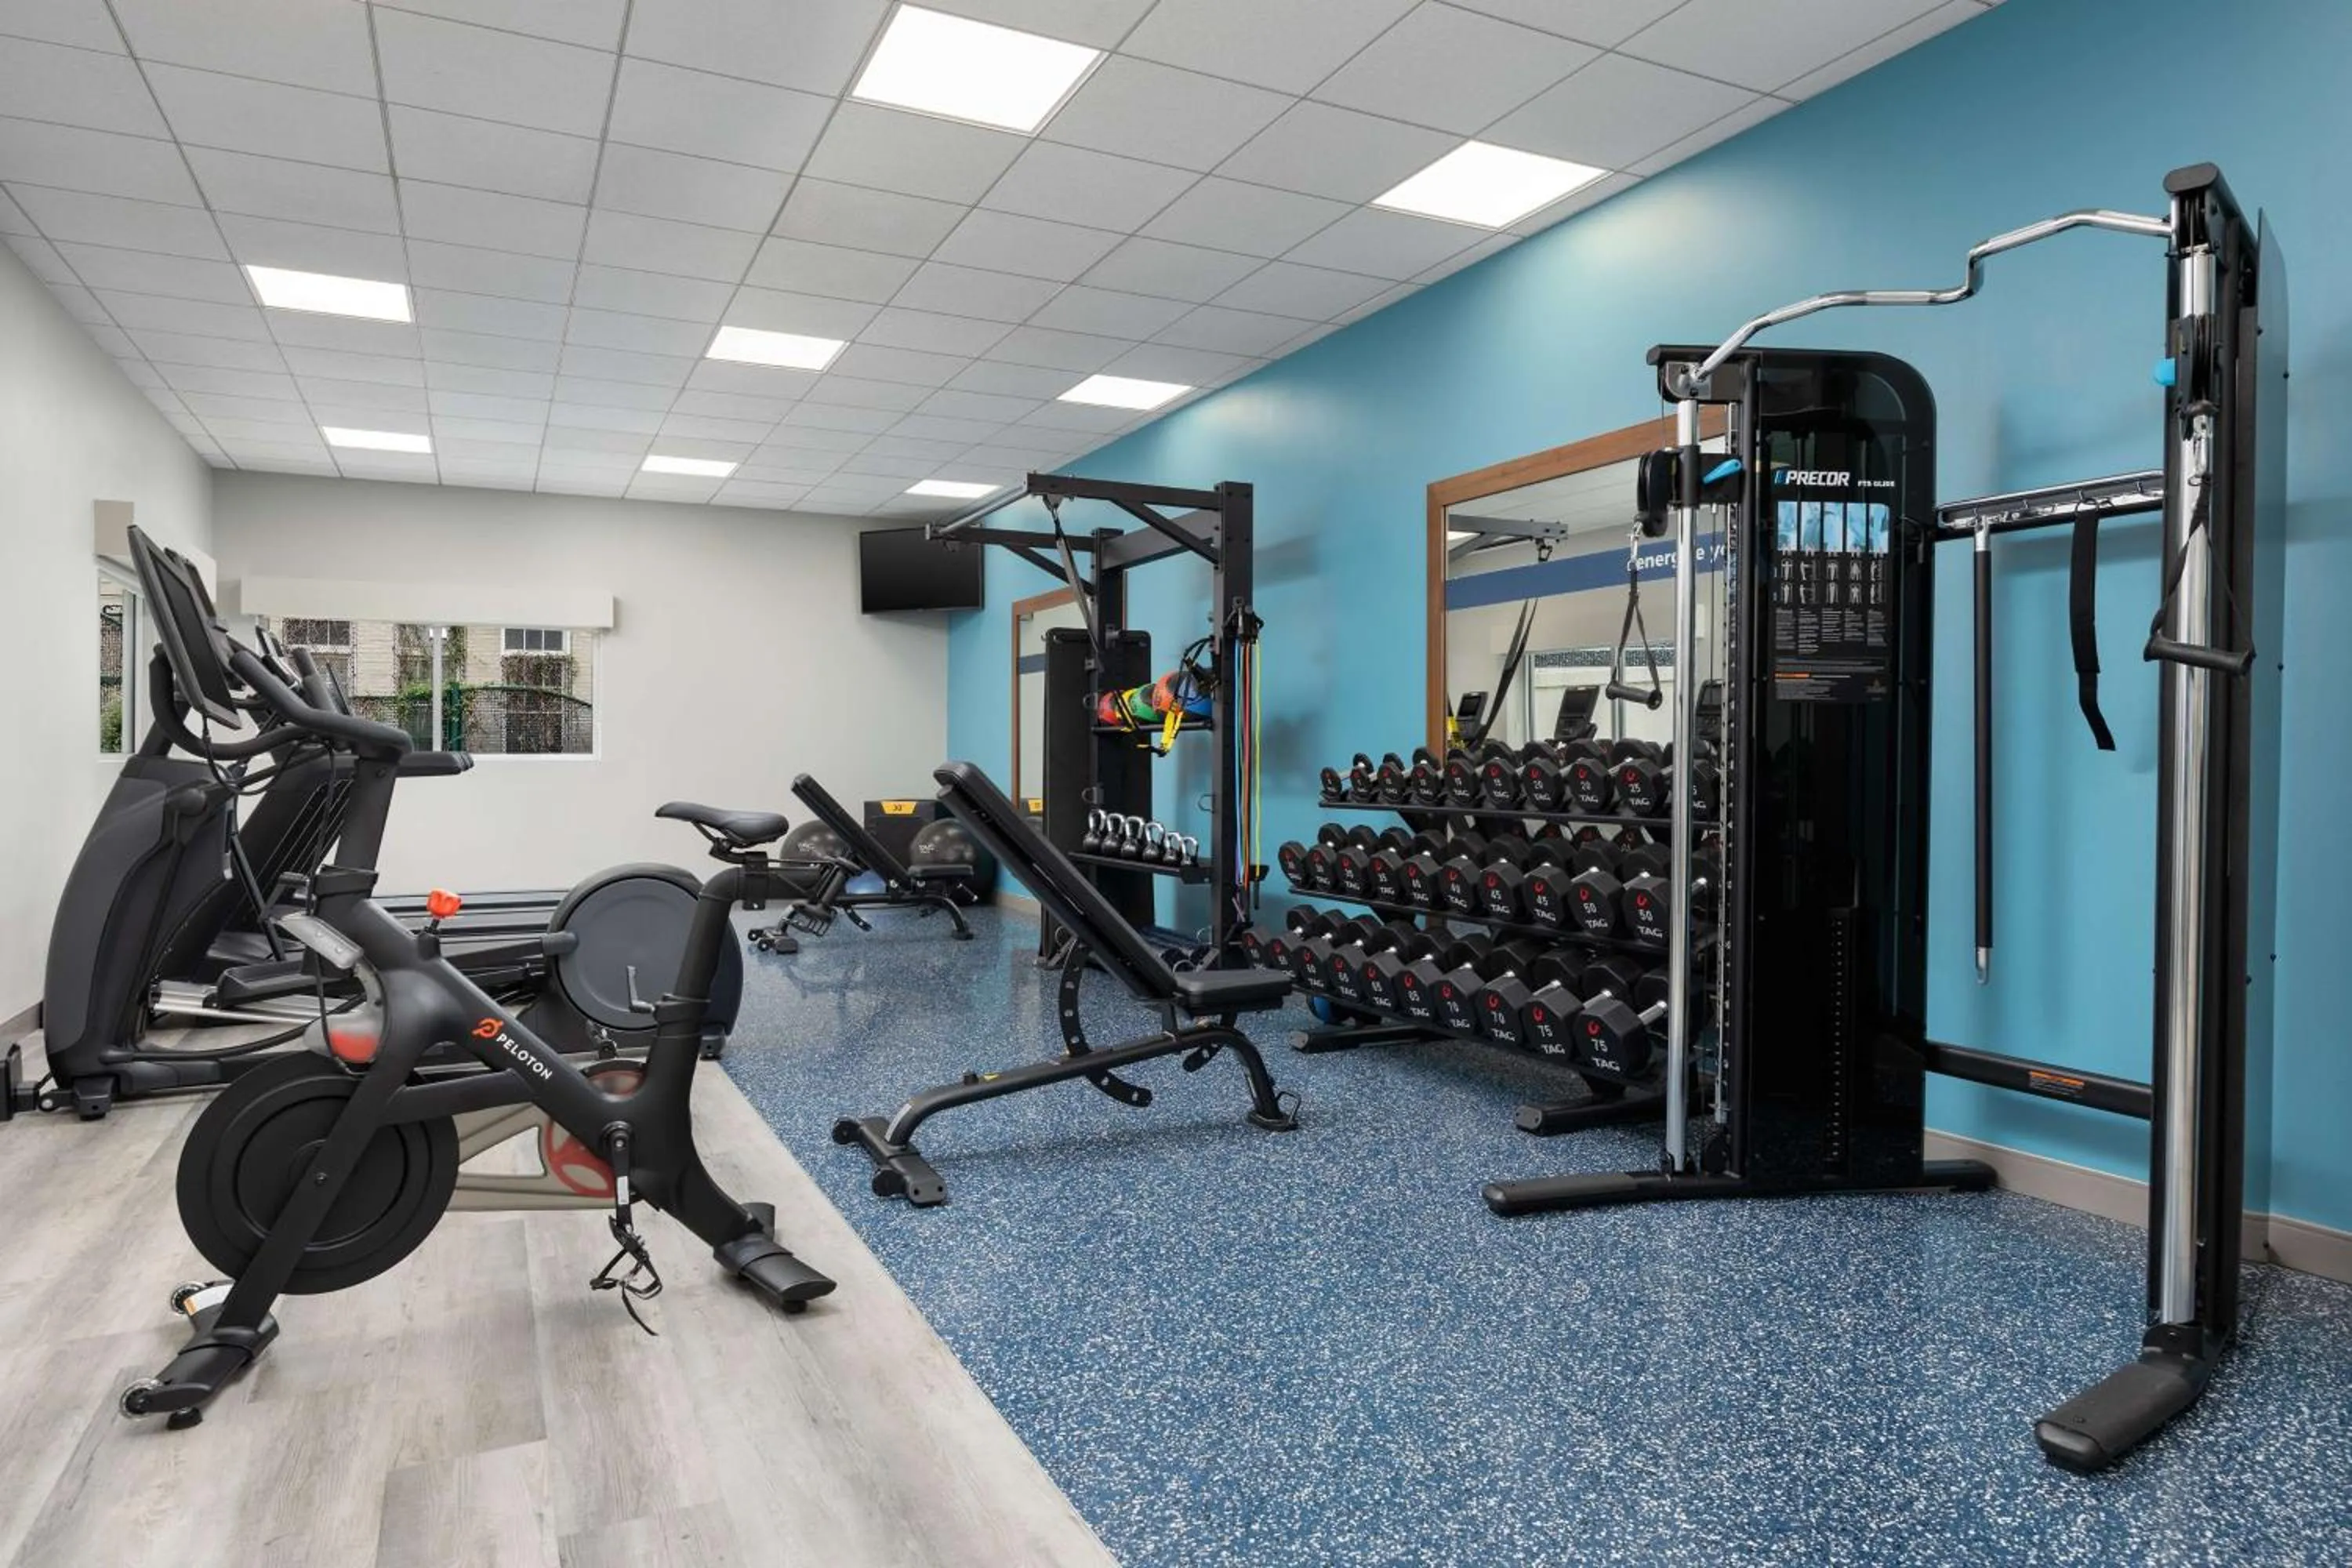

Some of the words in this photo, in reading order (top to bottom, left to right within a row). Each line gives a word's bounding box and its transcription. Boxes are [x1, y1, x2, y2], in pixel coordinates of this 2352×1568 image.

[1785, 470, 1850, 486] PRECOR
[1629, 783, 1642, 793] 25
[1580, 794, 1599, 804] TAG
[1413, 892, 1429, 902] TAG
[1490, 904, 1510, 914] TAG
[1583, 902, 1597, 913] 50
[1534, 908, 1556, 922] TAG
[1638, 909, 1653, 921] 50
[1585, 919, 1608, 928] TAG
[1637, 925, 1663, 938] TAG
[1340, 985, 1358, 998] TAG
[1374, 996, 1392, 1007] TAG
[1410, 1007, 1430, 1018] TAG
[1491, 1011, 1506, 1025] 70
[1450, 1018, 1470, 1029] TAG
[1491, 1028, 1515, 1042] TAG
[1537, 1025, 1554, 1038] 75
[1541, 1043, 1565, 1054] TAG
[1591, 1038, 1609, 1053] 75
[496, 1033, 553, 1080] PELOTON
[1592, 1057, 1621, 1073] TAG
